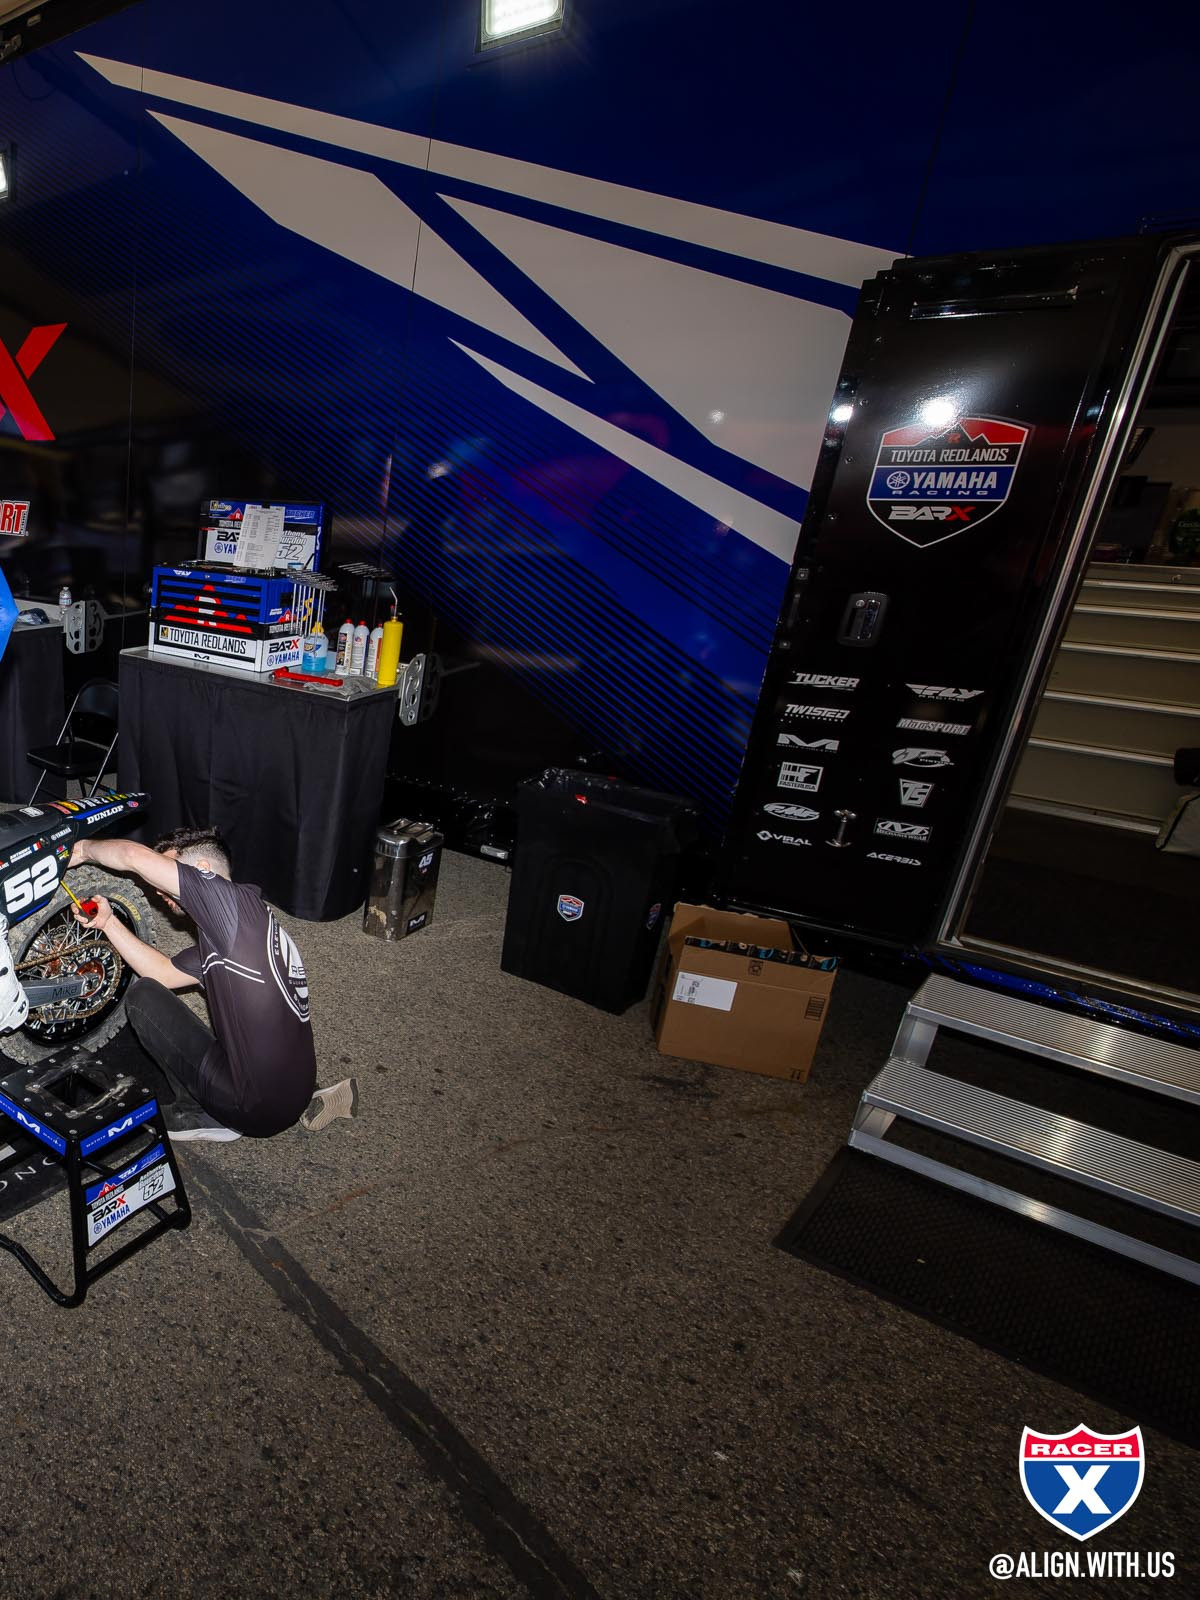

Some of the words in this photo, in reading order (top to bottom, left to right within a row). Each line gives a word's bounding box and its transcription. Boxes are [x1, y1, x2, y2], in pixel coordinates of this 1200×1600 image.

[890, 449, 936, 464] TOYOTA
[939, 448, 1009, 463] REDLANDS
[913, 471, 998, 489] YAMAHA
[888, 505, 976, 522] BARX
[275, 544, 303, 560] 52
[170, 628, 200, 645] TOYOTA
[201, 635, 247, 654] REDLANDS
[269, 638, 300, 653] BARX
[275, 650, 300, 666] YAMAHA
[794, 673, 860, 688] TUCKER
[910, 683, 985, 699] FLY
[785, 703, 851, 719] TWISTED
[87, 805, 124, 824] DUNLOP
[773, 833, 812, 846] VIRAL
[866, 852, 922, 866] ACERBIS
[4, 855, 60, 915] 52
[52, 984, 80, 1001] Mika
[142, 1175, 165, 1201] 52
[92, 1193, 127, 1222] BARX
[102, 1204, 131, 1228] YAMAHA
